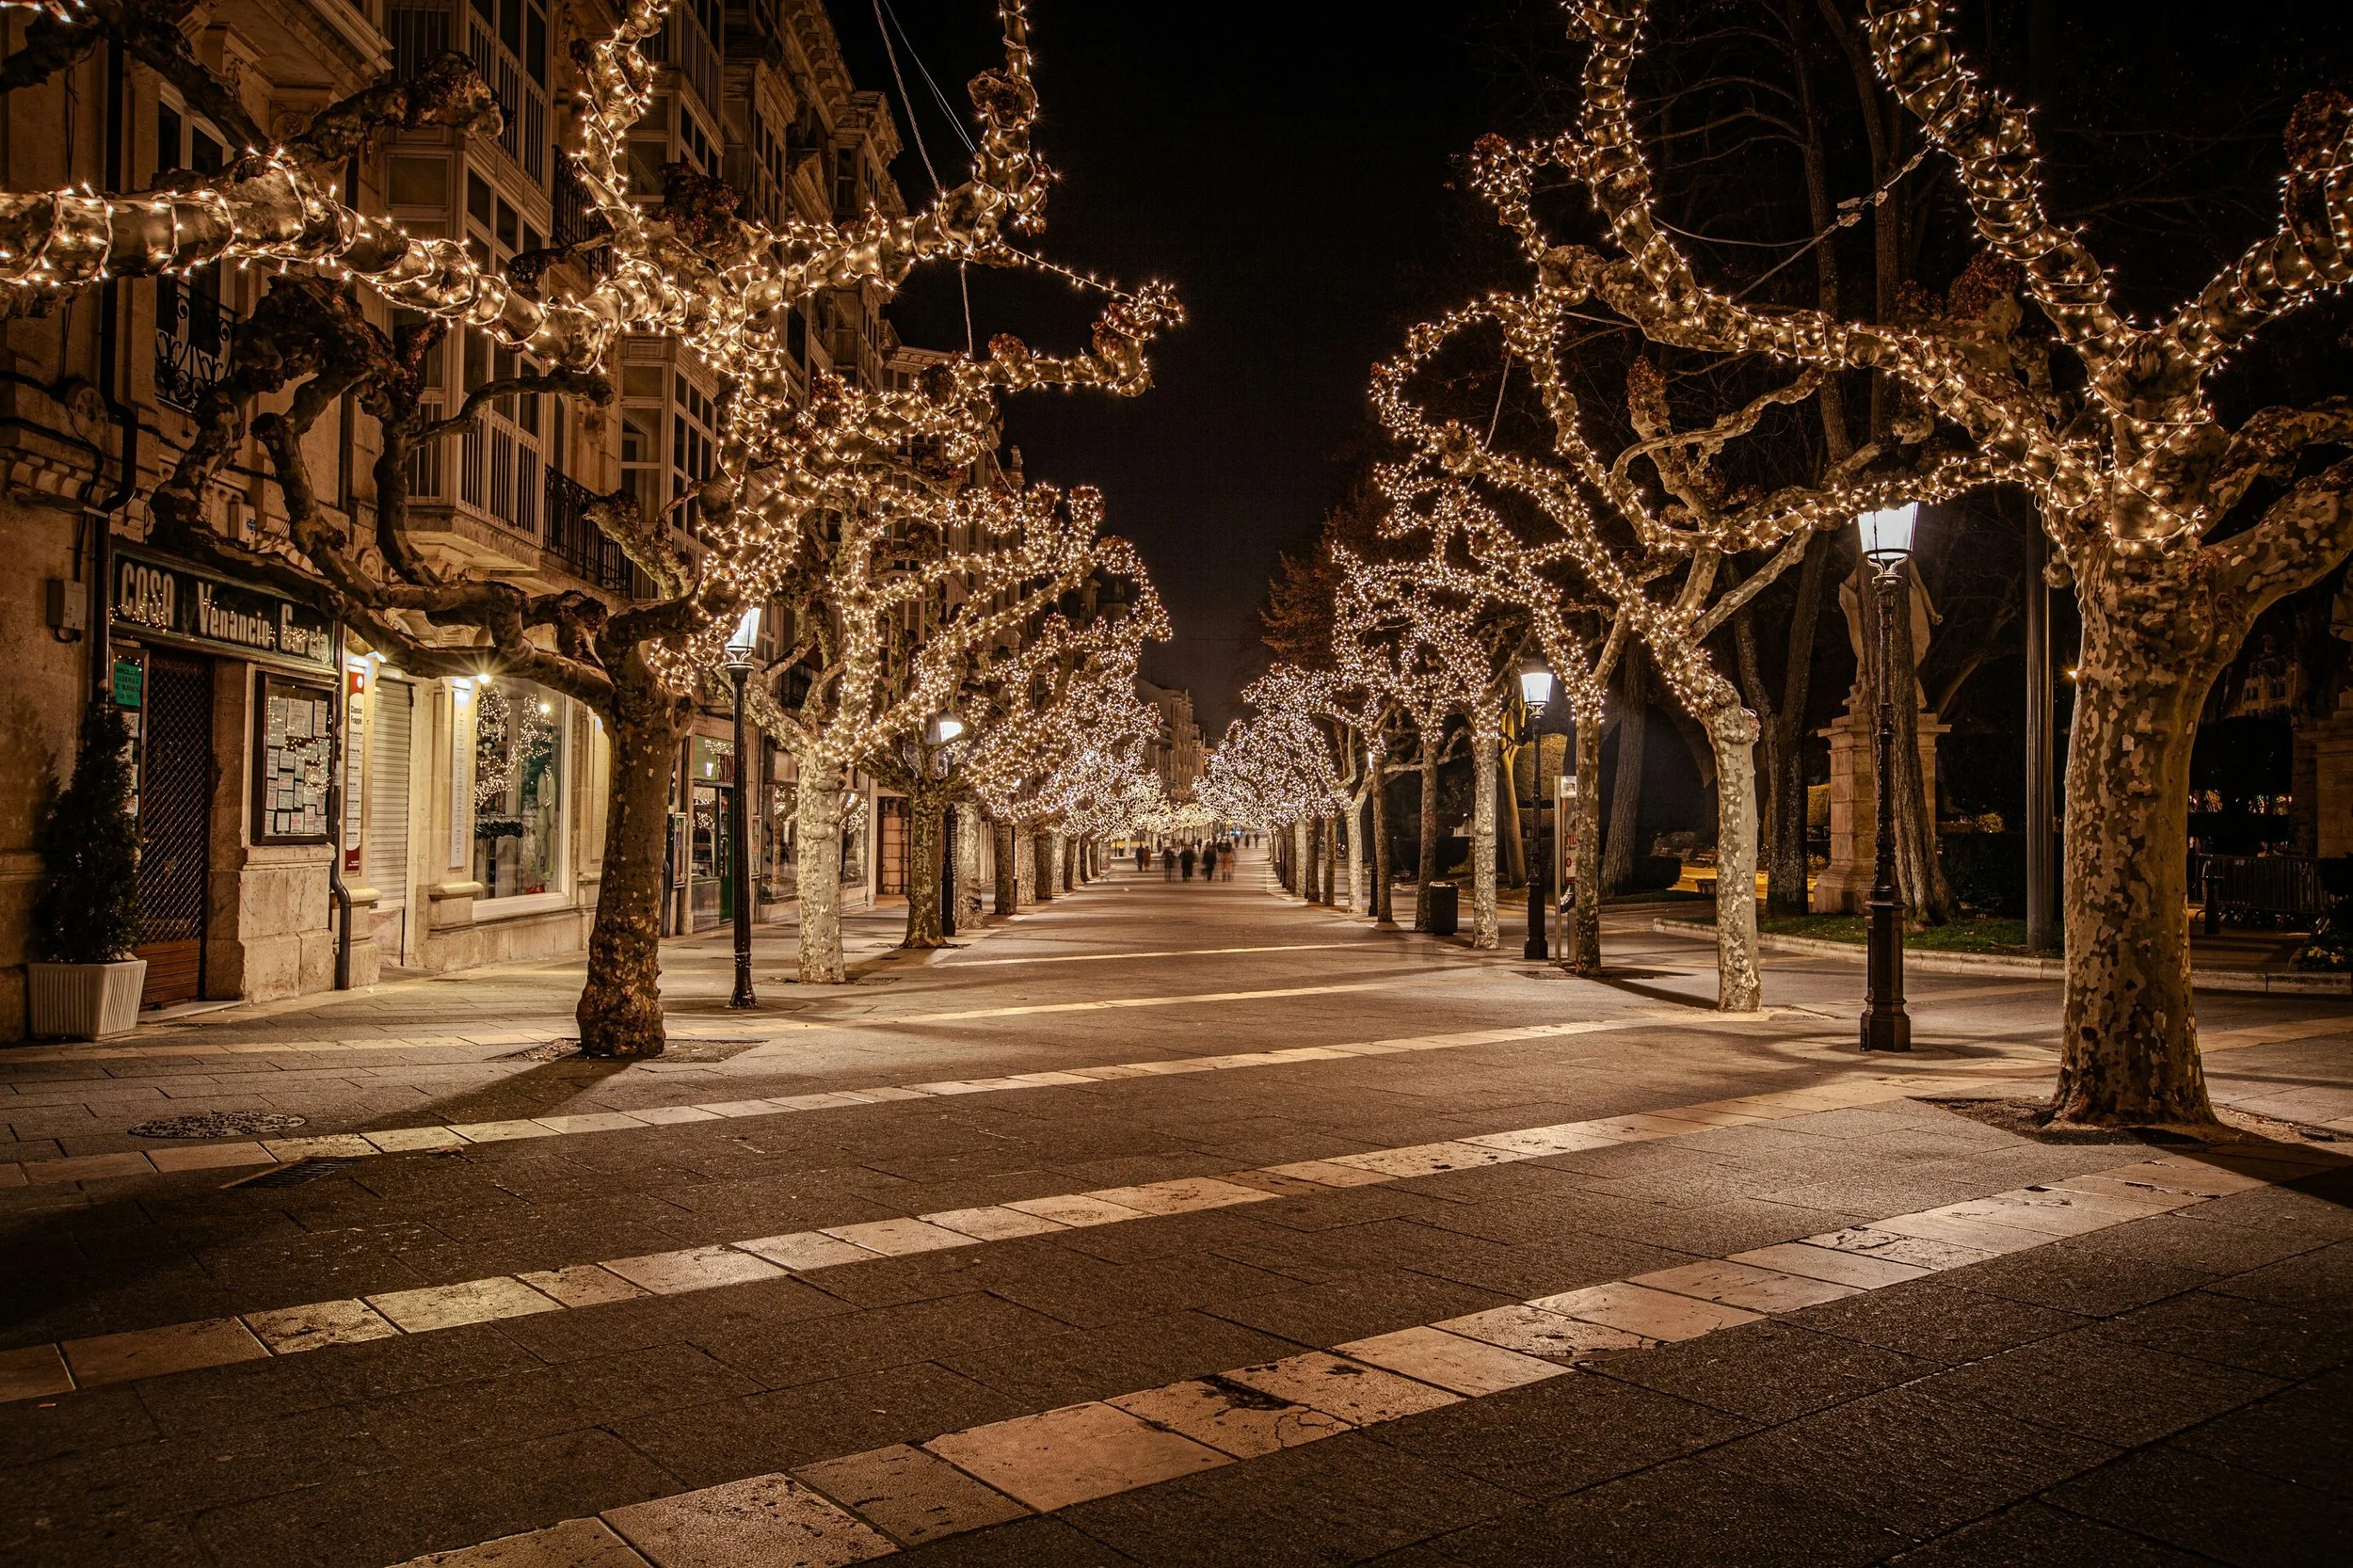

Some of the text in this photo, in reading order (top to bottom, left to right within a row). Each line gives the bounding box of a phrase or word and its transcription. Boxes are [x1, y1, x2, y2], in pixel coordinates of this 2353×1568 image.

[121, 562, 176, 629] CASA
[197, 581, 270, 648] Venancio
[351, 705, 362, 714] Classic
